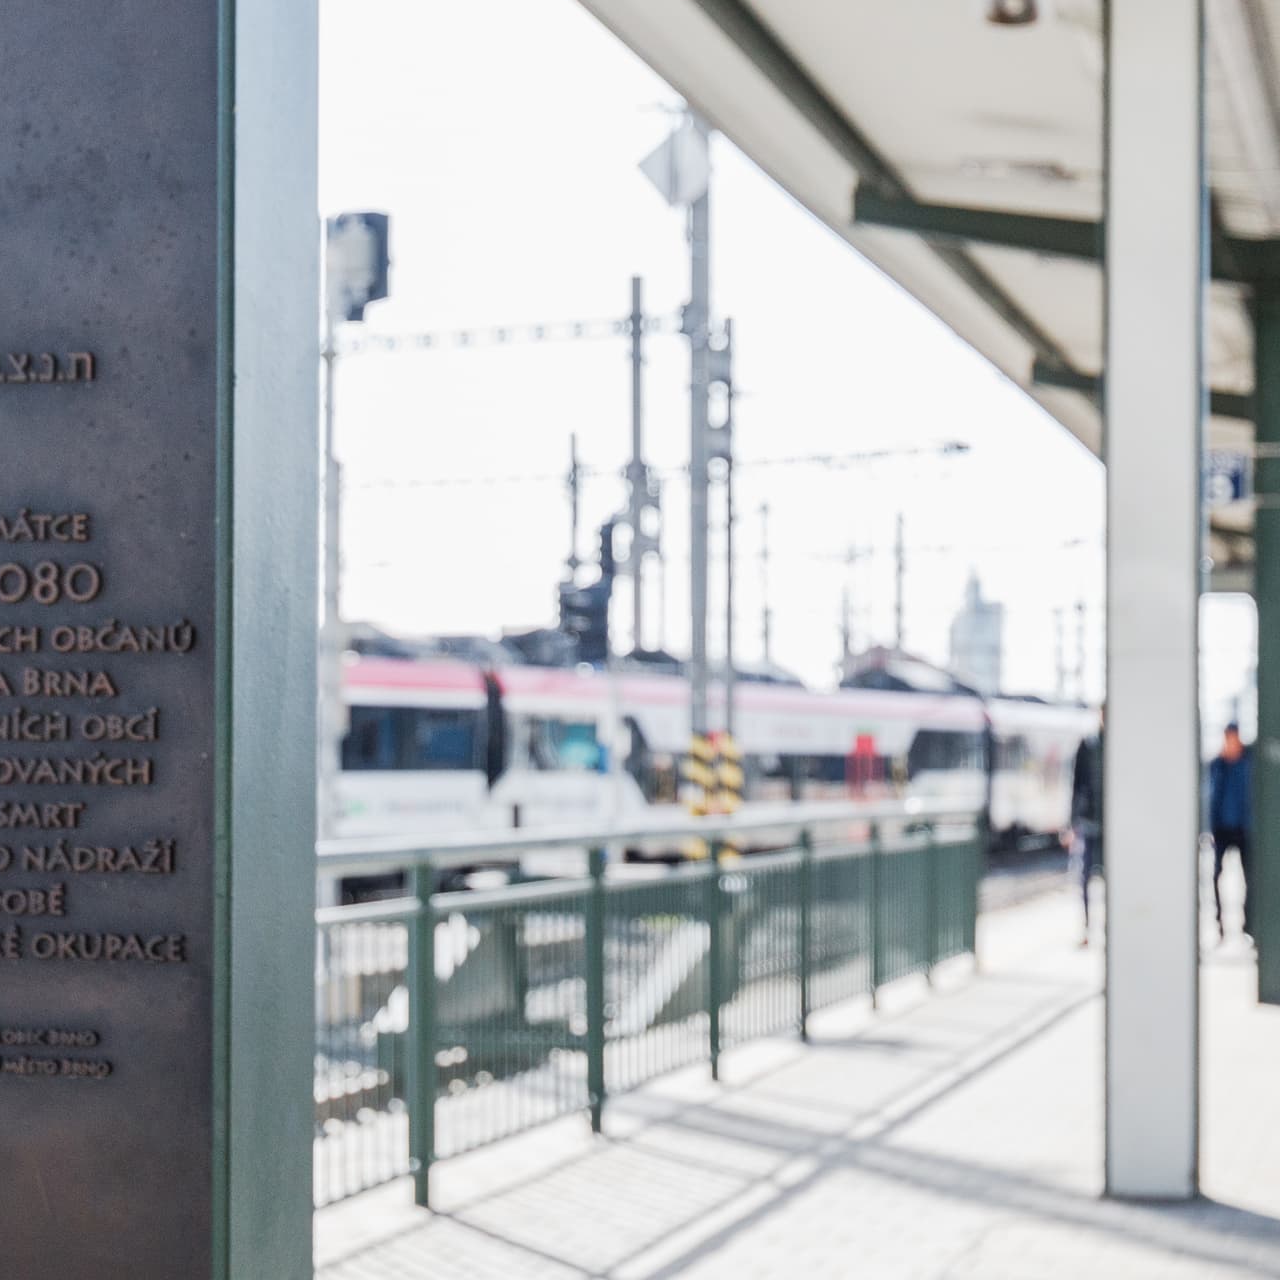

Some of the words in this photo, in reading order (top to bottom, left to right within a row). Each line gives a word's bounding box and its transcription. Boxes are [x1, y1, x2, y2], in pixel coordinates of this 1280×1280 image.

[50, 618, 197, 654] OBČANŮ
[23, 667, 118, 697] BRNA
[81, 707, 161, 742] OBCÍ
[22, 839, 177, 873] NÁDRAŽÍ
[32, 933, 188, 962] OKUPACE
